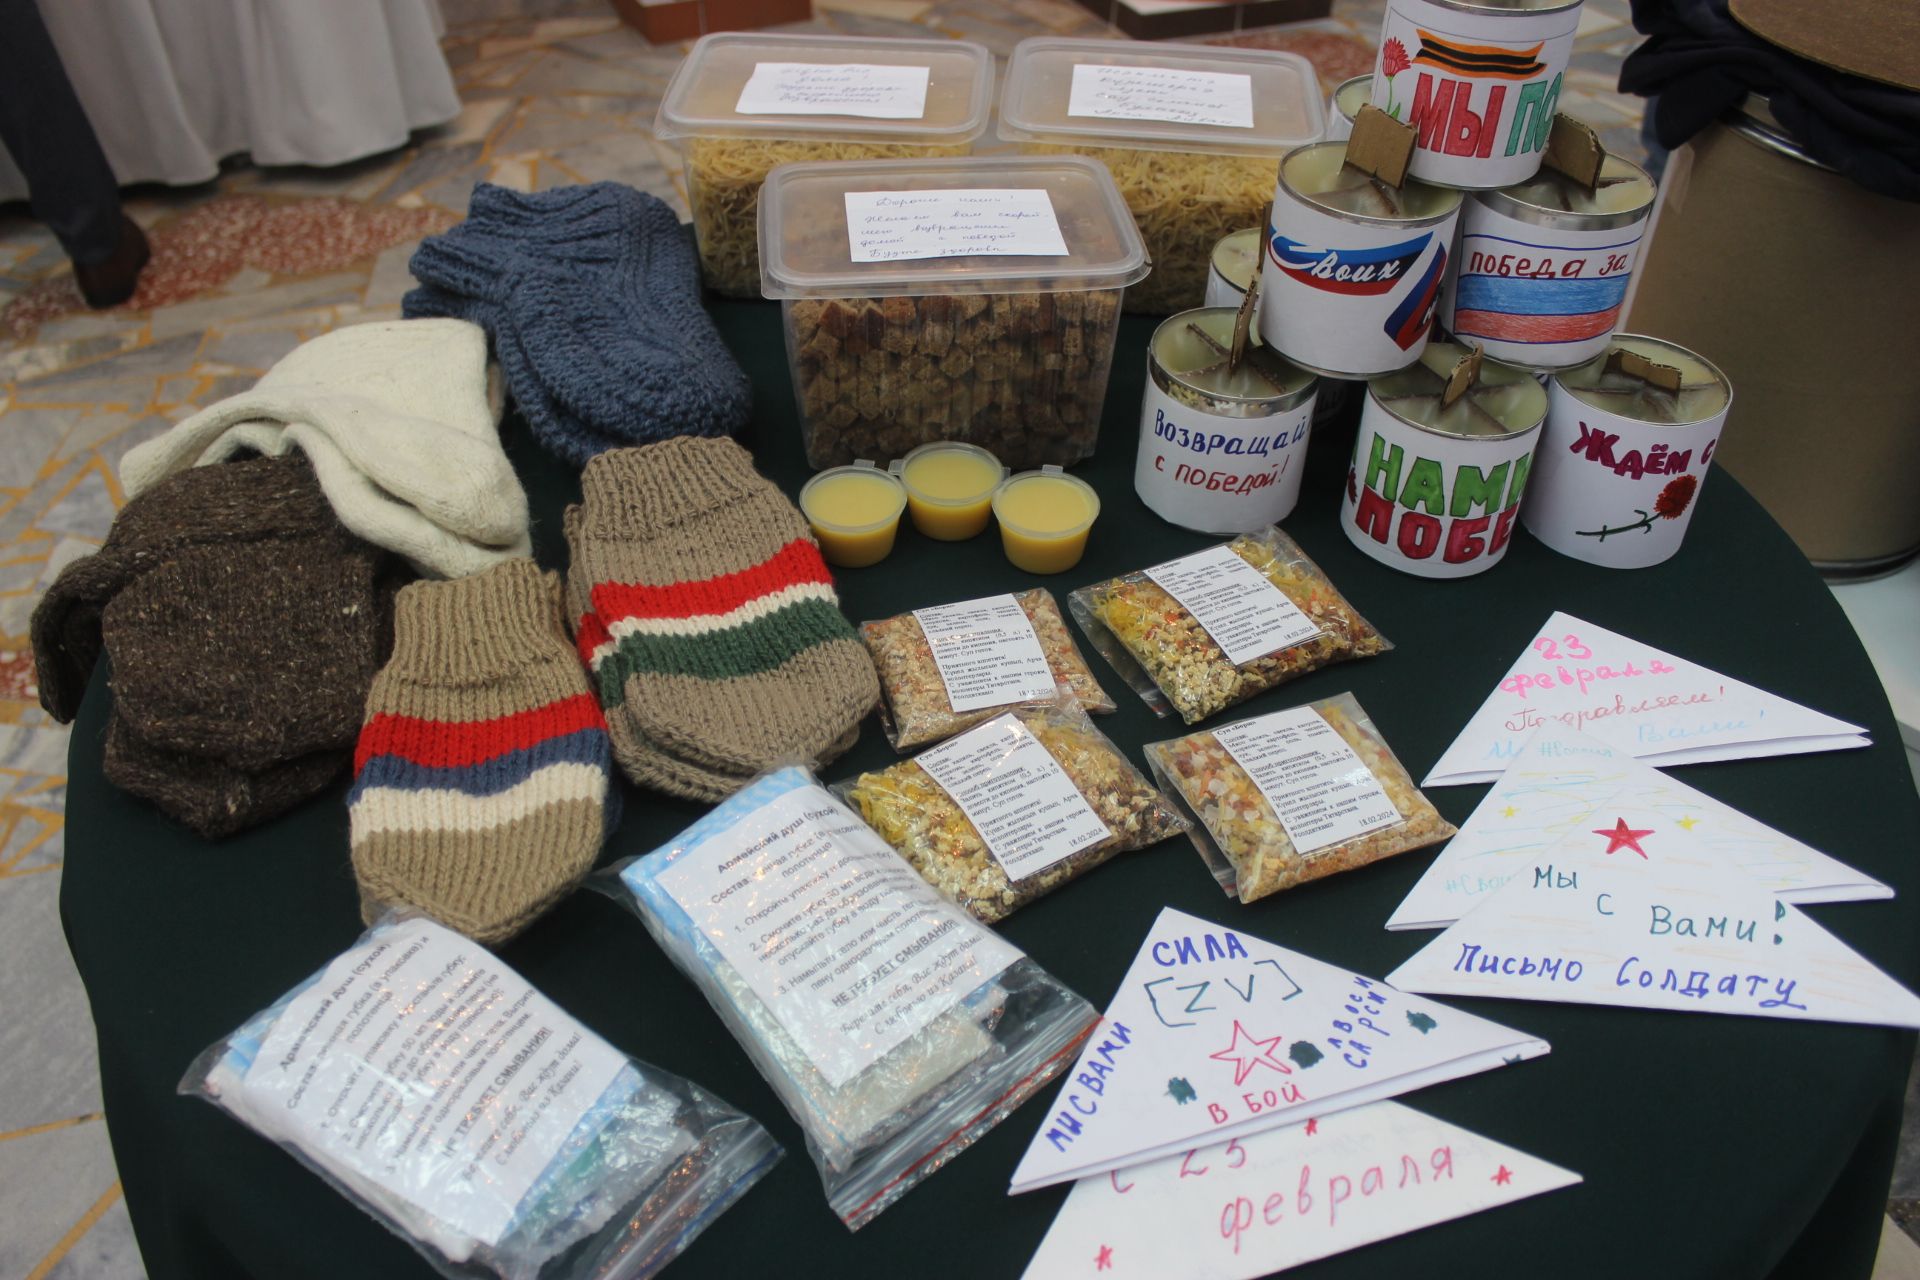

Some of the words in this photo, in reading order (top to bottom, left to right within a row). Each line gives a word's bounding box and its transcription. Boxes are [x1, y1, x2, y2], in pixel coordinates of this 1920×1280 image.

[1409, 73, 1506, 159] МЫ
[1154, 408, 1311, 457] Возвращай
[1534, 634, 1593, 660] 23
[1505, 685, 1725, 731] Подравляем!
[780, 817, 804, 838] душ
[1068, 827, 1103, 847] 18.02.2024
[1359, 810, 1394, 826] 18.02.2024
[1533, 864, 1577, 889] Мы
[1650, 899, 1787, 945] Вами!
[1152, 932, 1249, 967] СИЛА
[1453, 943, 1583, 982] Письмо
[1616, 956, 1807, 1010] Солдату
[1220, 1145, 1457, 1255] февраля
